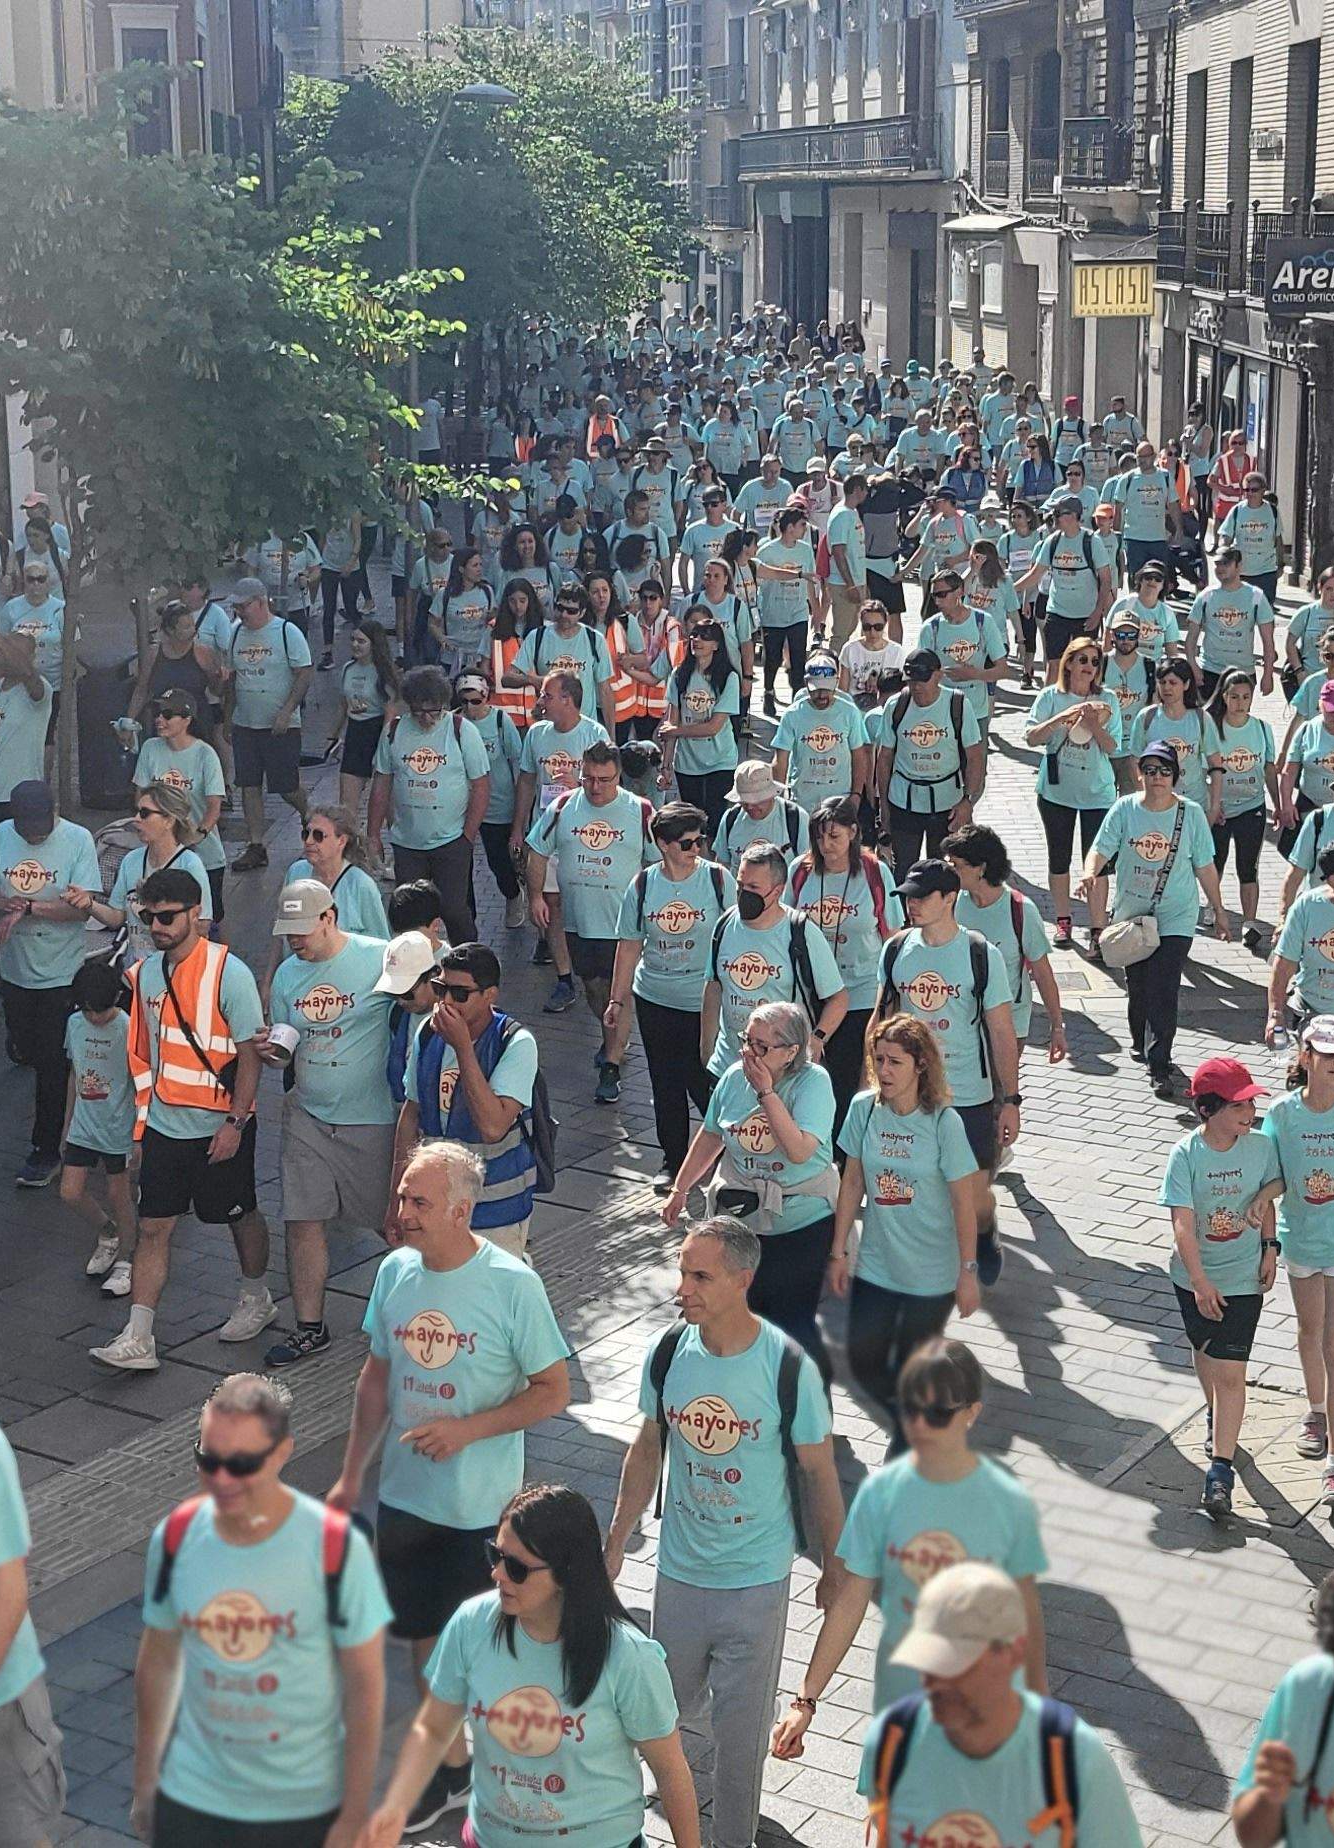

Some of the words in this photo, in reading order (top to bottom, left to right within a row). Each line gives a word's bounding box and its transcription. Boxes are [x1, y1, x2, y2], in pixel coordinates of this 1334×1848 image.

[1079, 266, 1149, 306] ASCASO
[1271, 293, 1306, 303] CENTRO
[570, 827, 625, 844] +mayores
[1127, 836, 1172, 854] +mayor
[2, 867, 58, 885] +mayores
[647, 908, 706, 926] +mayores
[721, 961, 782, 981] +mayores
[898, 981, 961, 1002] +mayores
[293, 992, 356, 1015] +mayores
[727, 1123, 770, 1146] +mayo
[393, 1323, 479, 1357] +mayores
[666, 1404, 763, 1443] +mayores
[470, 1699, 587, 1743] +mayores
